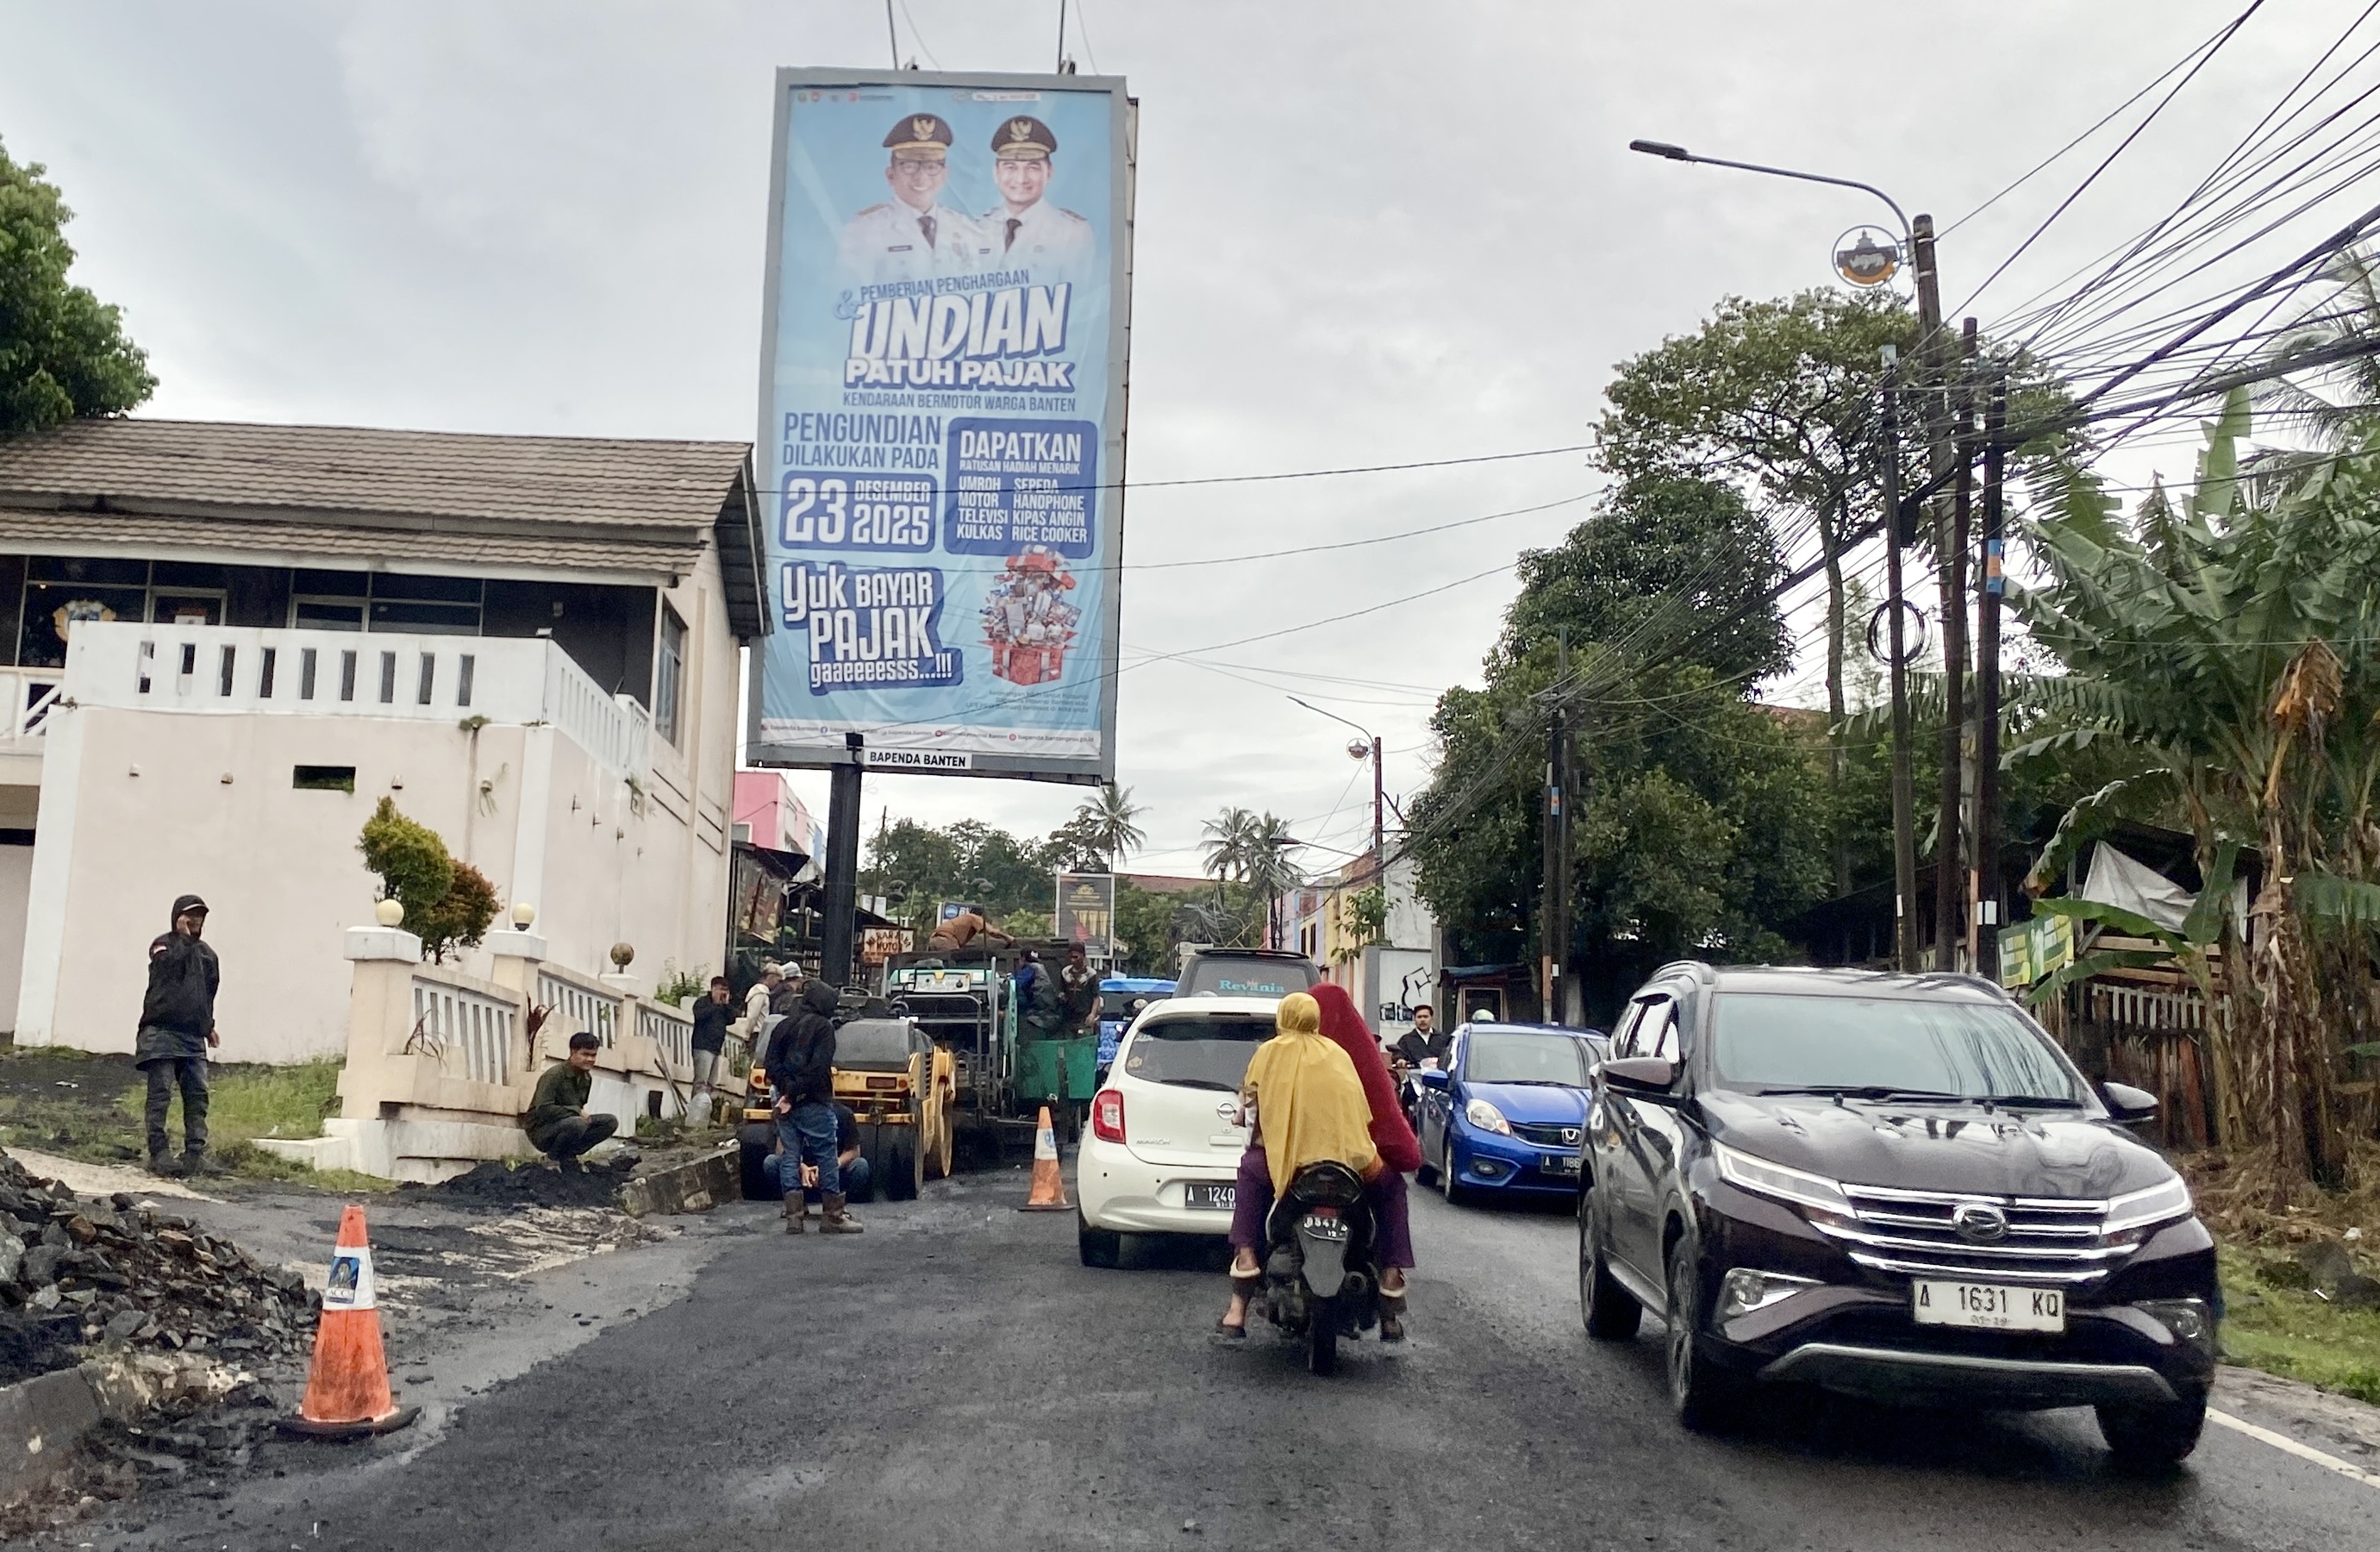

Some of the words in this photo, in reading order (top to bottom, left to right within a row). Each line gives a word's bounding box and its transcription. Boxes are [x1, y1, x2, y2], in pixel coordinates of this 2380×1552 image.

[860, 281, 934, 300] PEMBERIAN
[937, 269, 1030, 292] PENGHARGAAN
[851, 282, 1071, 360] UNDIAN
[845, 360, 955, 388] PATUH
[959, 360, 1075, 392] PAJAK
[843, 392, 915, 407] KENDARAAN
[917, 394, 981, 409] BERMOTOR
[984, 395, 1026, 410] WARGA
[1029, 397, 1076, 411] BANTEN
[784, 412, 940, 445] PENGUNDIAN
[959, 430, 1081, 461] DAPATKAN
[783, 444, 886, 467] DILAKUKAN
[891, 447, 939, 469] PADA
[959, 460, 1002, 472] RATUSAN
[1003, 461, 1037, 473] HADIAH
[1039, 461, 1081, 474] MENARIK
[854, 479, 931, 503] DESEMBER
[959, 476, 1001, 491] UMROH
[1014, 478, 1059, 494] SEPEDA
[959, 491, 999, 507] MOTOR
[1013, 493, 1084, 510] HANDPHONE
[785, 478, 847, 543] 23
[958, 508, 1009, 524] TELEVISI
[1013, 510, 1046, 526] KIPAS
[1049, 510, 1085, 527] ANGIN
[852, 504, 930, 545] 2025
[957, 524, 1003, 540] KULKAS
[1012, 526, 1039, 541] RICE
[1040, 527, 1088, 543] COOKER
[855, 571, 934, 607] BAYAR
[809, 606, 934, 662] PAJAK
[870, 752, 921, 765] BAPENDA
[923, 754, 965, 767] BANTEN
[1545, 1156, 1551, 1166] A
[1187, 1186, 1195, 1202] A
[1208, 1186, 1236, 1202] 1240
[1920, 1284, 1930, 1307] A
[1958, 1286, 2006, 1313] 1631
